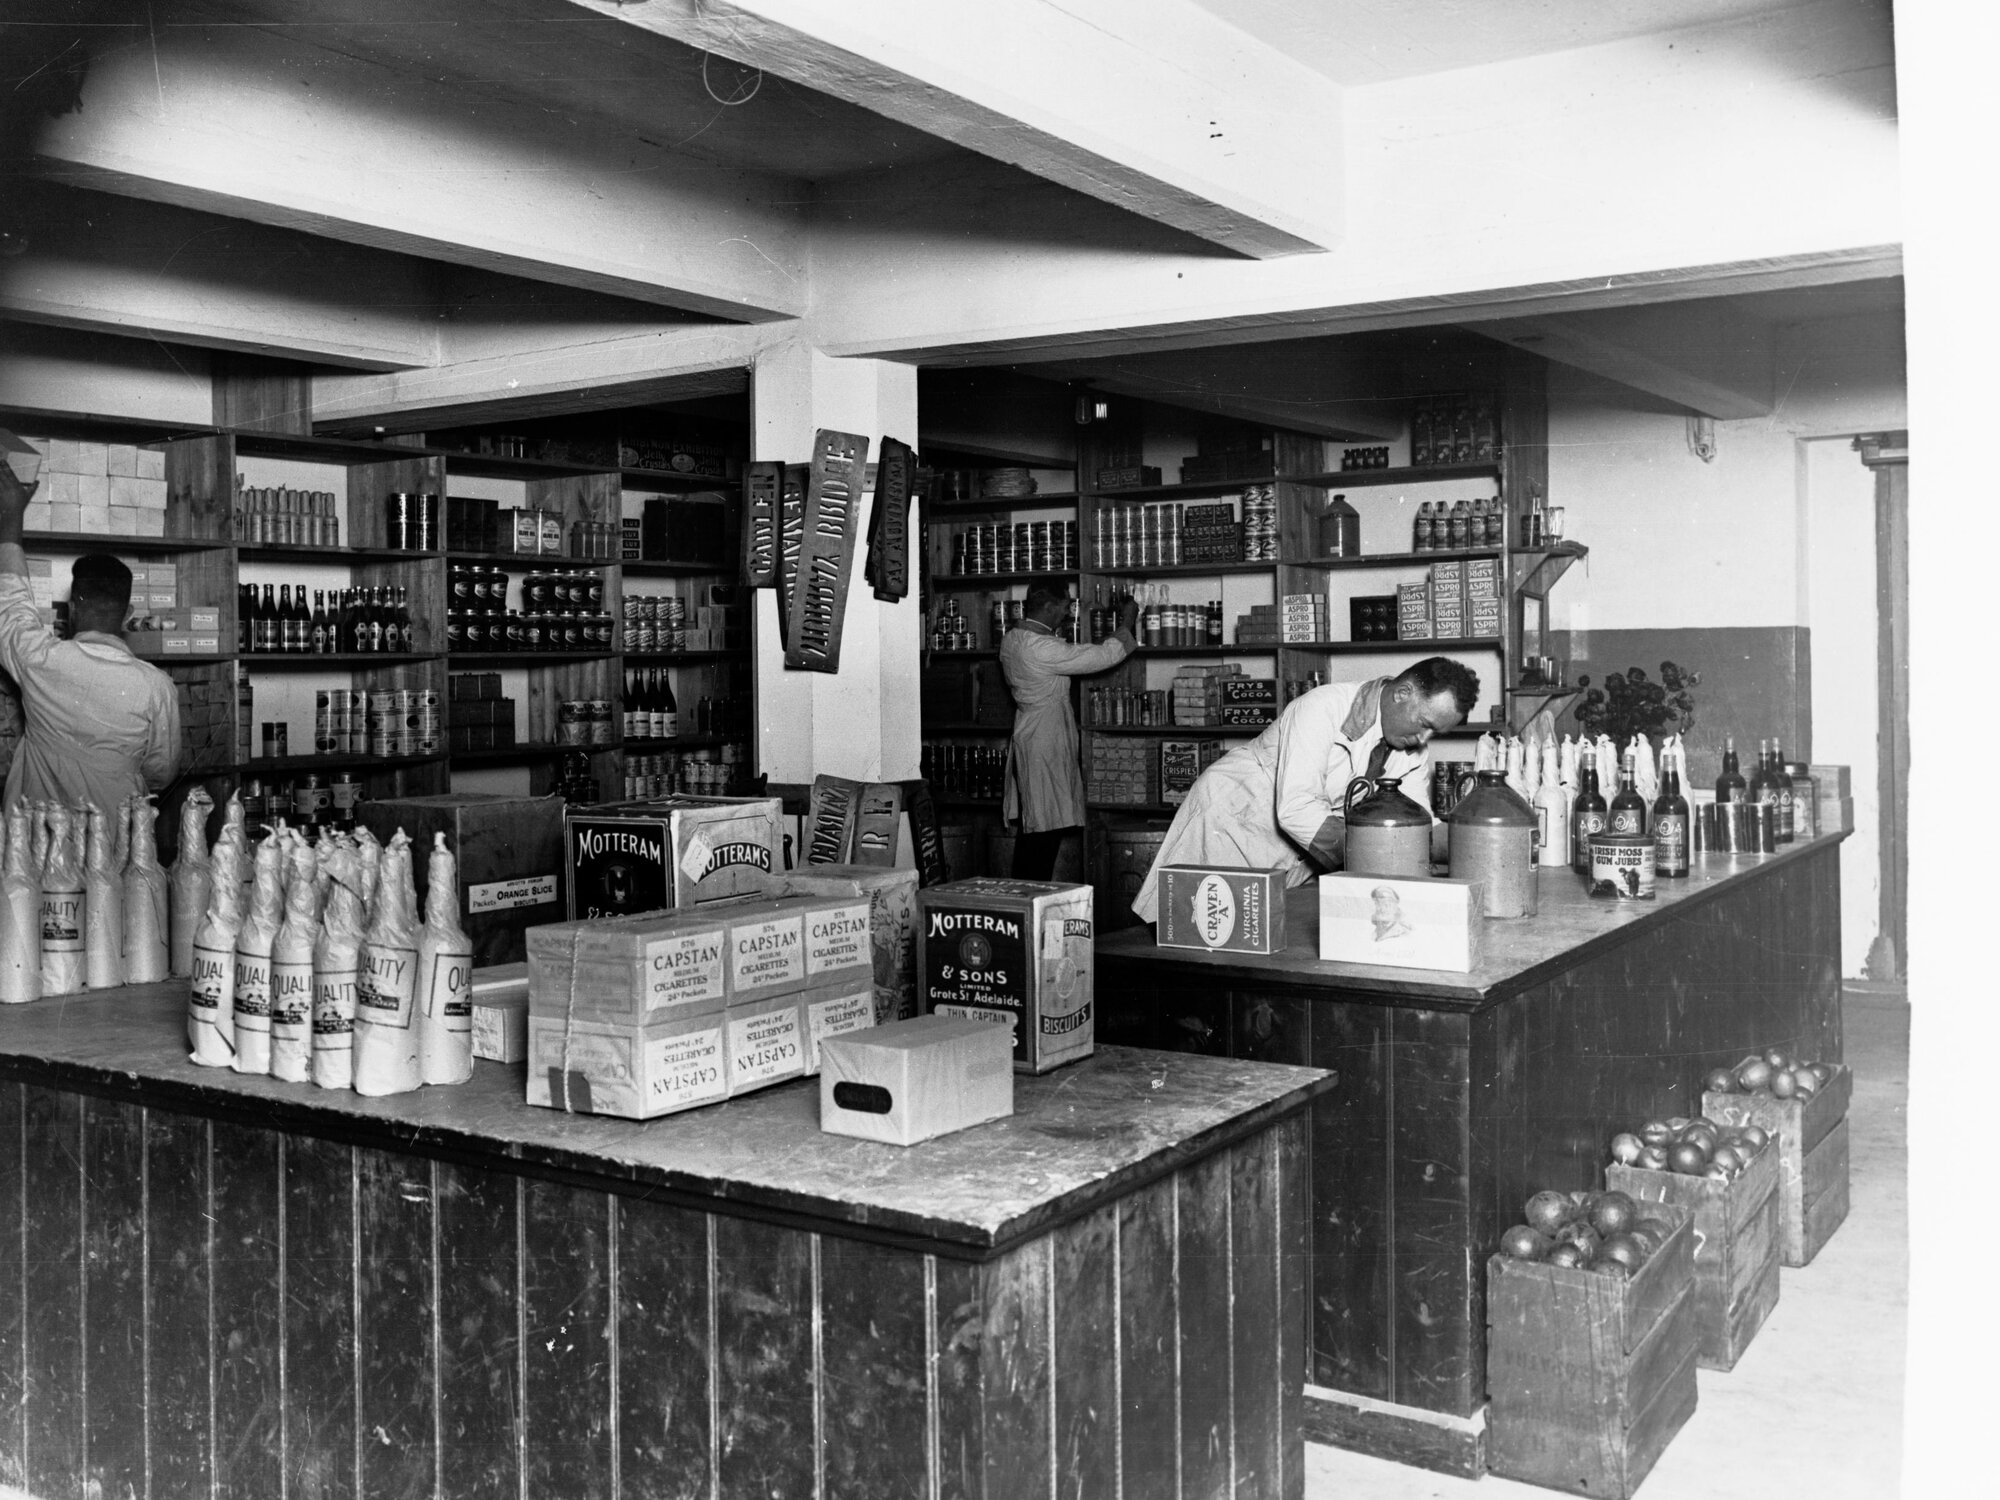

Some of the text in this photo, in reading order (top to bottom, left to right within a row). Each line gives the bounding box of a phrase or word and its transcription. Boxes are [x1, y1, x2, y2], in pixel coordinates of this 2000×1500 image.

[750, 474, 775, 574] GAWLER
[801, 443, 856, 657] MURRAY BRIDGE
[1434, 571, 1460, 579] ASPRO
[1401, 592, 1425, 600] ASPRO
[1435, 584, 1460, 592] ASPRO
[1289, 614, 1310, 622] ASPRO
[1437, 622, 1461, 630] ASPRO
[1289, 624, 1310, 632] ASPRO
[1402, 623, 1426, 631] ASPRO
[1232, 690, 1272, 700] COCOA
[1165, 766, 1196, 776] CRISPIES
[576, 828, 661, 867] MOTTERAM
[1594, 846, 1616, 857] IRISH
[1618, 848, 1642, 857] MOSS
[702, 844, 770, 878] OTTERAM'S
[1596, 856, 1642, 866] GUM JUBES
[1168, 874, 1174, 884] 10
[497, 885, 554, 900] ORANGE SLICE
[42, 900, 80, 921] ALITY
[473, 900, 496, 908] Packets
[1208, 882, 1219, 941] CRAVEN
[1251, 882, 1260, 946] CIGARETTES
[812, 918, 866, 938] CAPSTAN
[928, 912, 1019, 940] MOTTERAM
[739, 930, 798, 954] CAPSTAN
[654, 946, 718, 970] CAPSTAN
[812, 944, 858, 958] CIGARETTES
[358, 952, 406, 985] UALITY
[740, 958, 789, 975] CIGARETTES
[836, 956, 858, 965] Packets
[765, 971, 788, 980] Packets
[942, 965, 1008, 984] & SONS
[654, 975, 708, 992] CIGARETTES
[960, 984, 992, 992] LIMITED
[682, 988, 707, 998] Packets
[930, 986, 958, 1000] Grote
[974, 993, 1024, 1007] Adelaide.
[746, 1018, 770, 1028] Packets
[824, 1008, 868, 1025] CIGARETTES
[947, 1008, 1007, 1024] THIN CAPTAIN
[1044, 1008, 1087, 1034] BISCUITS
[746, 1022, 794, 1041] CIGARETTES
[664, 1040, 690, 1050] Packets
[664, 1045, 716, 1065] CIGARETTES
[738, 1042, 796, 1071] CAPSTAN
[653, 1066, 718, 1095] CAPSTAN
